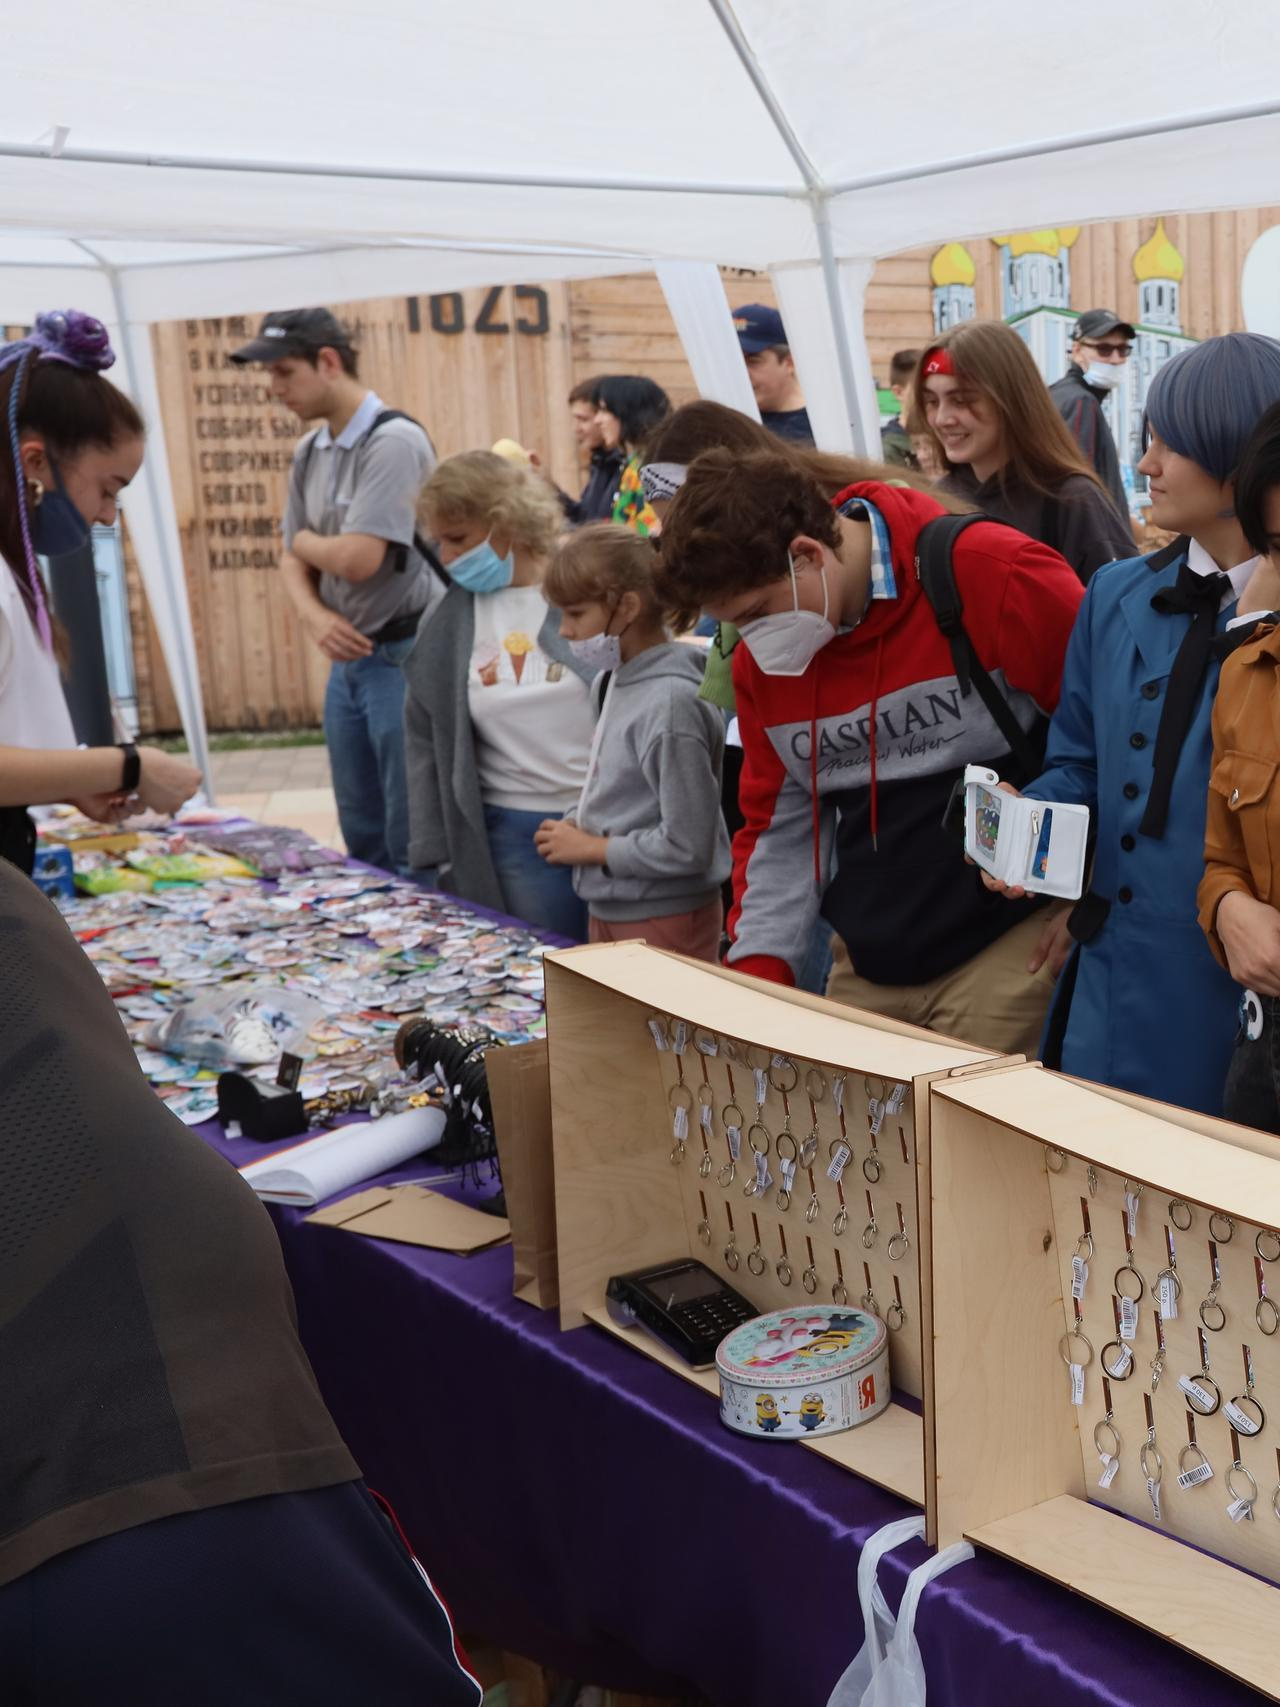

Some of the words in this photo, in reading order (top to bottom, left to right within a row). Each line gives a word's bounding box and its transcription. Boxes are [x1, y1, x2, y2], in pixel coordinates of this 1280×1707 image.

[790, 688, 963, 762] CASPIAN
[818, 749, 890, 776] Peaceul
[900, 731, 966, 759] Water
